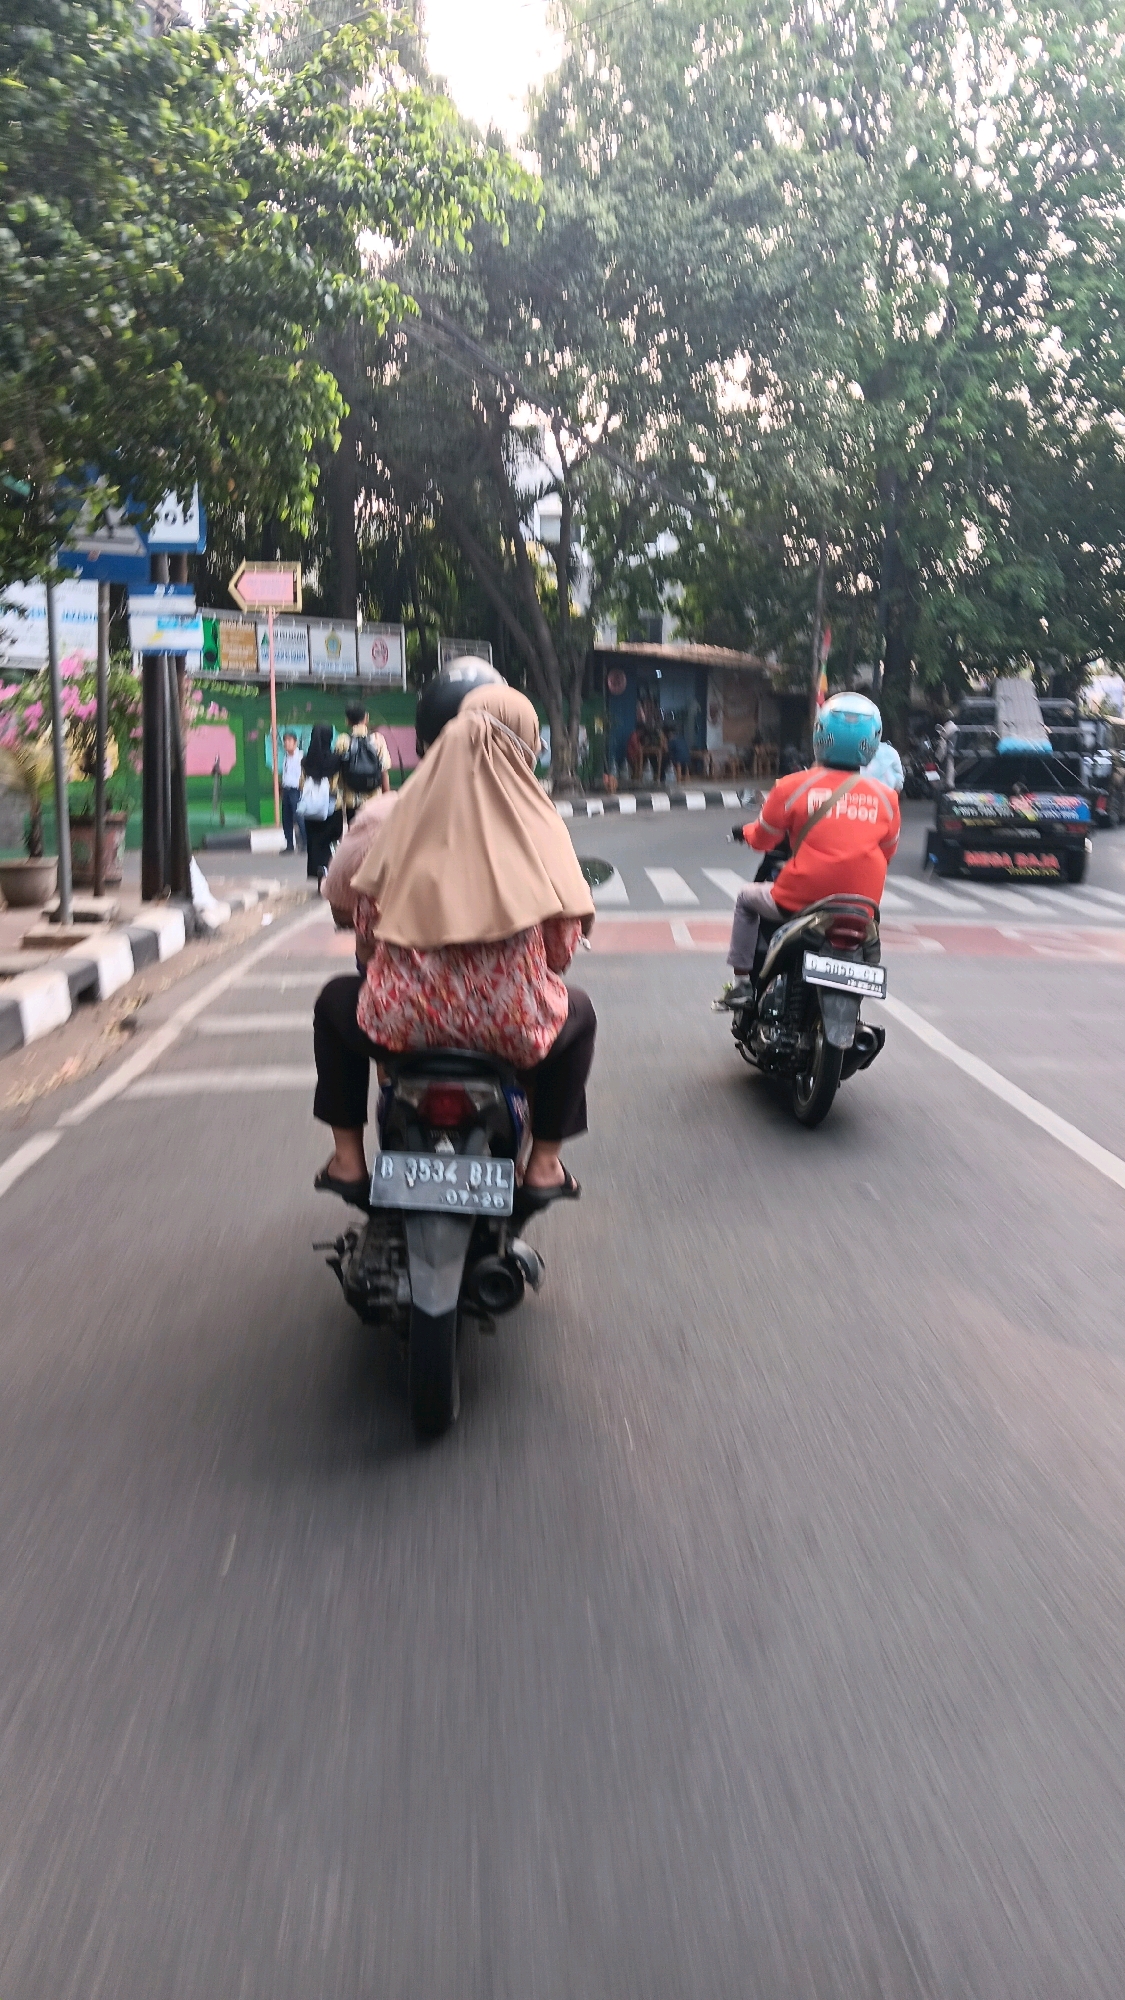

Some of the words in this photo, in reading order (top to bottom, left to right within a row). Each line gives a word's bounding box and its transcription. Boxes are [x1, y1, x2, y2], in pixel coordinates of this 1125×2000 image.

[835, 798, 879, 825] Food
[380, 1155, 394, 1180] B
[405, 1157, 458, 1184] 3534
